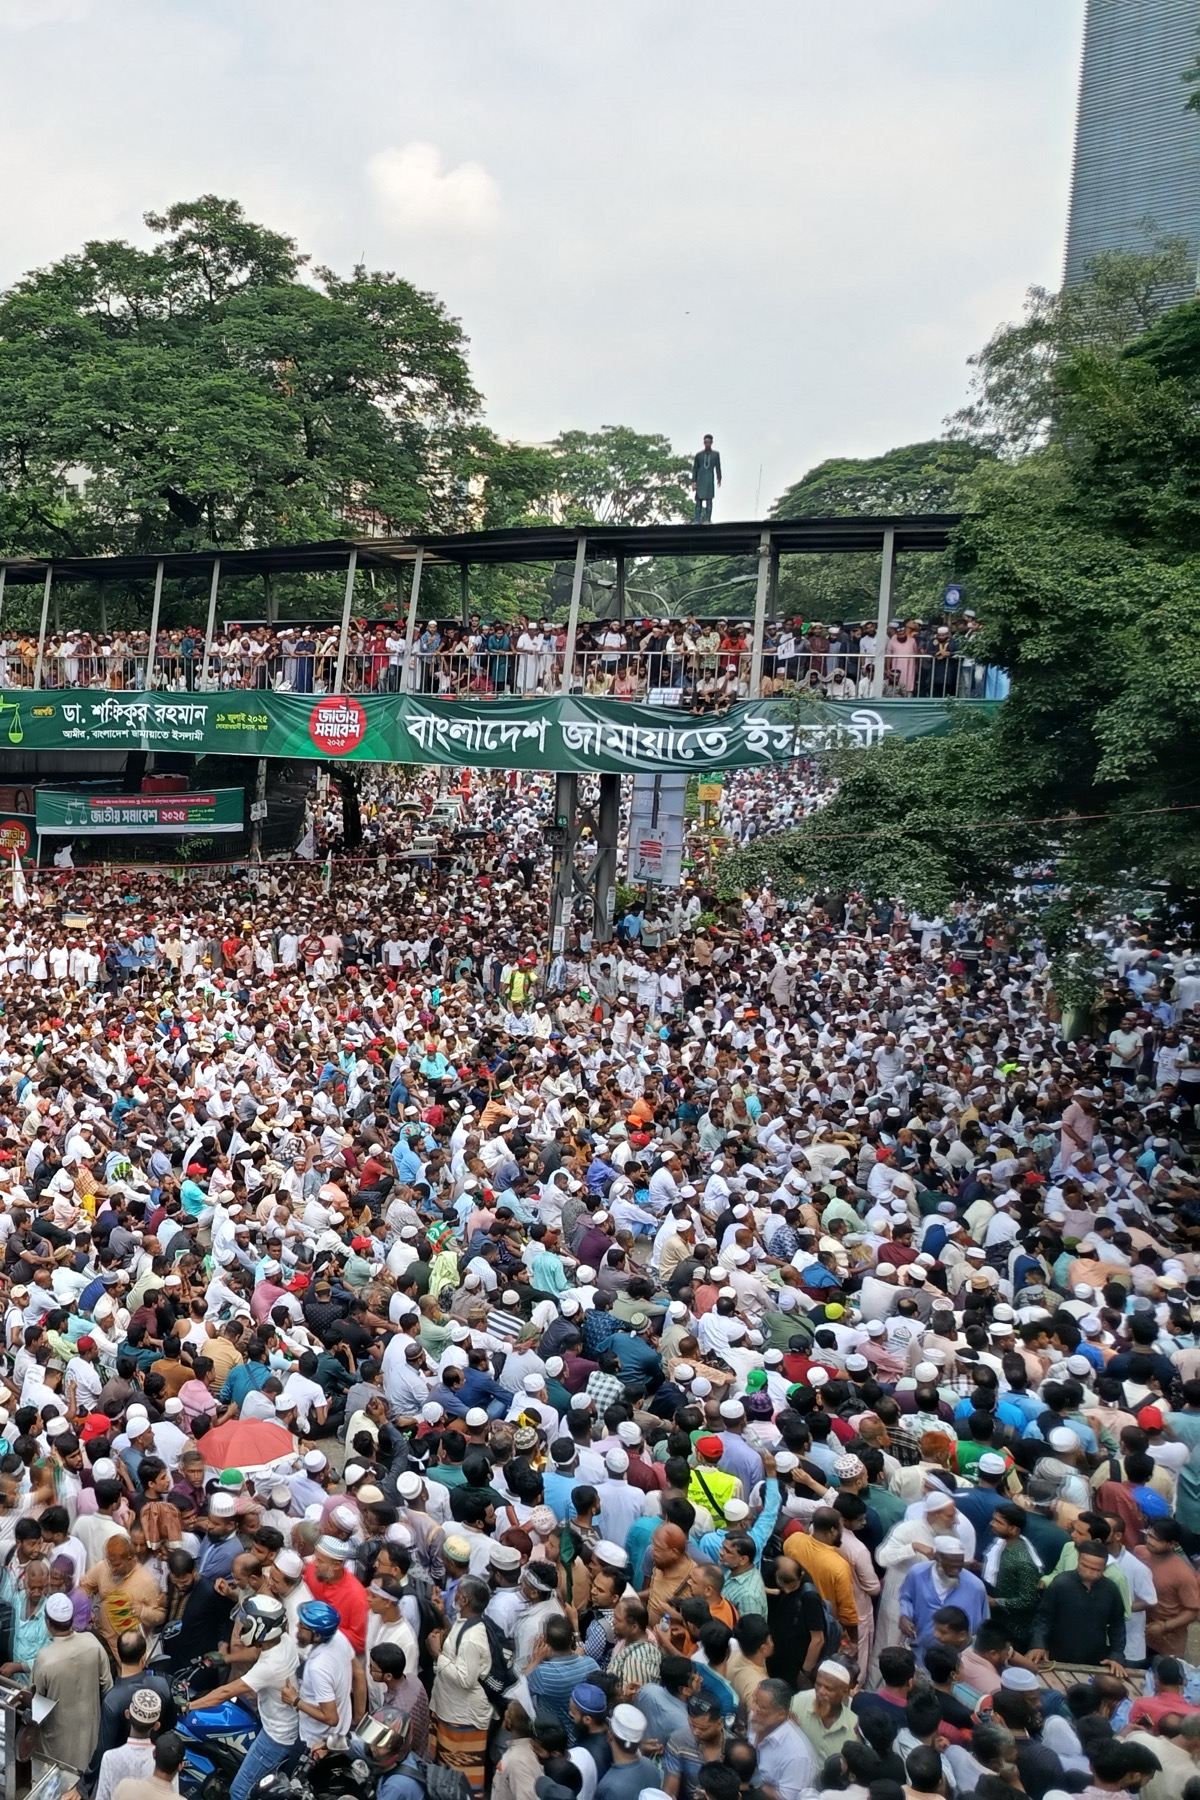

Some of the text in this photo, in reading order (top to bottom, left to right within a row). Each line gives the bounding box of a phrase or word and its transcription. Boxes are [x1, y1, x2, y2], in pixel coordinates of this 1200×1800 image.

[61, 698, 209, 727] ডা. শফিকুর রহমান
[216, 712, 268, 724] ১৯ জুলাই ২০২৫
[318, 705, 358, 724] জাতীয়
[92, 729, 128, 740] বাংলাদেশ
[131, 730, 170, 741] জামায়াতে
[171, 729, 204, 742] ইসলামী
[315, 722, 360, 738] সমাবেশ
[405, 712, 553, 754] বাংলাদেশ
[558, 717, 733, 760] জামায়াতে
[327, 738, 345, 747] ২০২৫
[90, 806, 120, 824] জাতীয়
[121, 809, 158, 824] সমাবেশ
[161, 809, 186, 822] ২০২৫
[0, 827, 26, 839] জাতীয়
